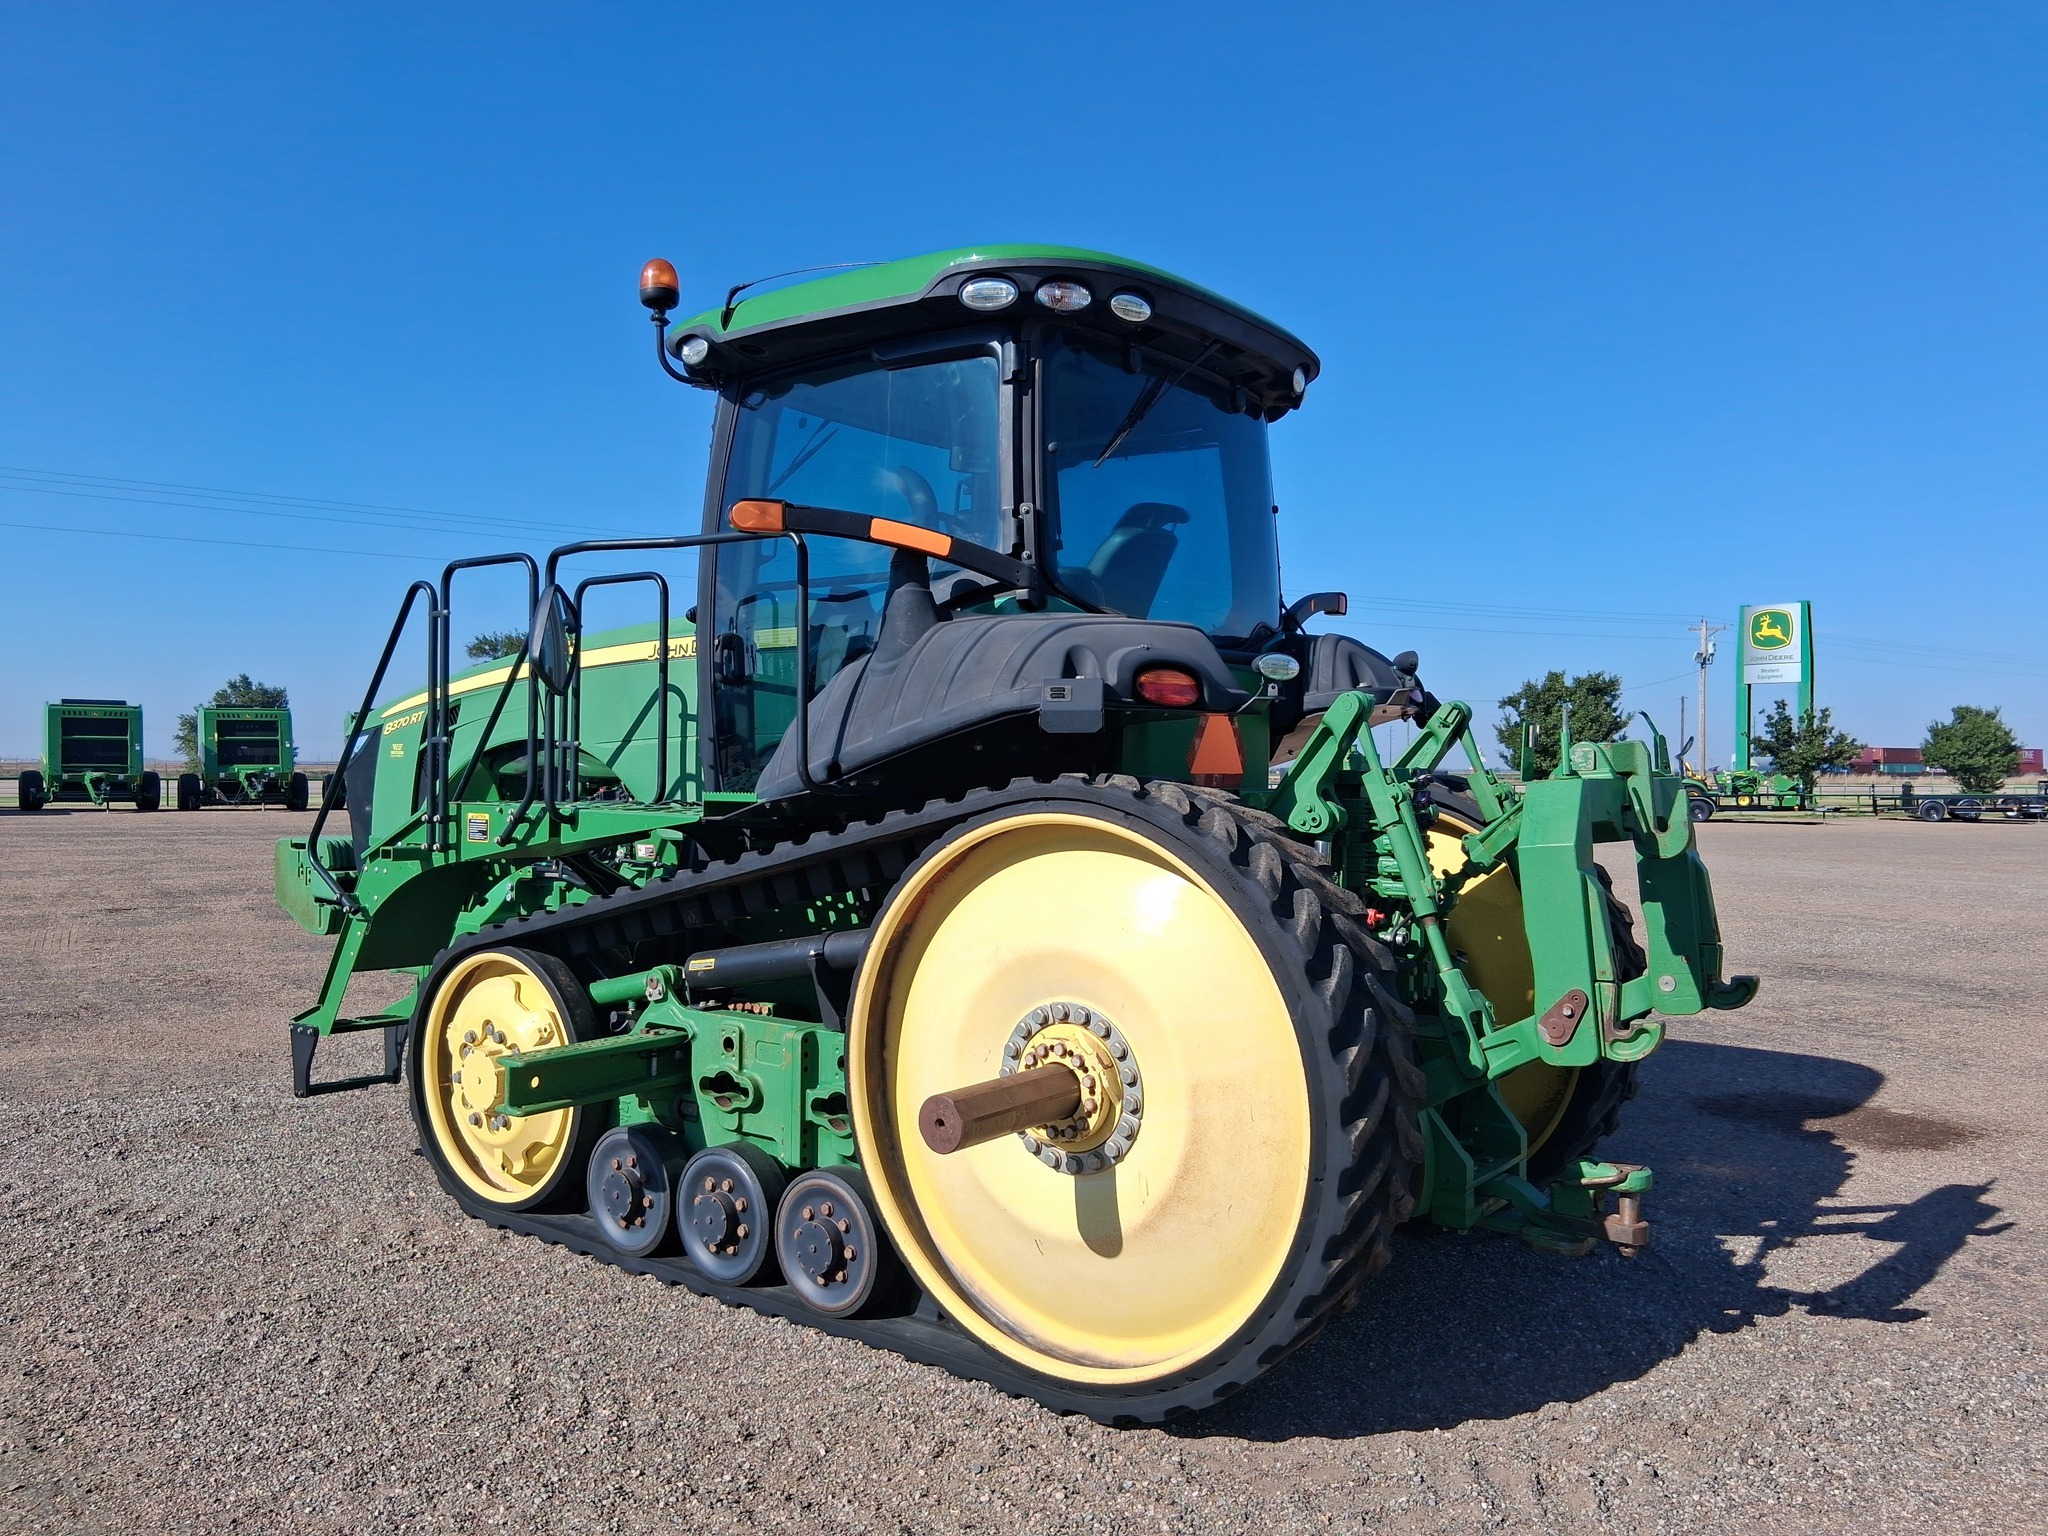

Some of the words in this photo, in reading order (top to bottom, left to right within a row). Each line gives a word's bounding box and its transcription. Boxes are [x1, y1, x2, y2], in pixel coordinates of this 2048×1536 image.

[648, 643, 689, 658] JHN
[383, 716, 410, 735] 8370
[410, 710, 425, 725] RT
